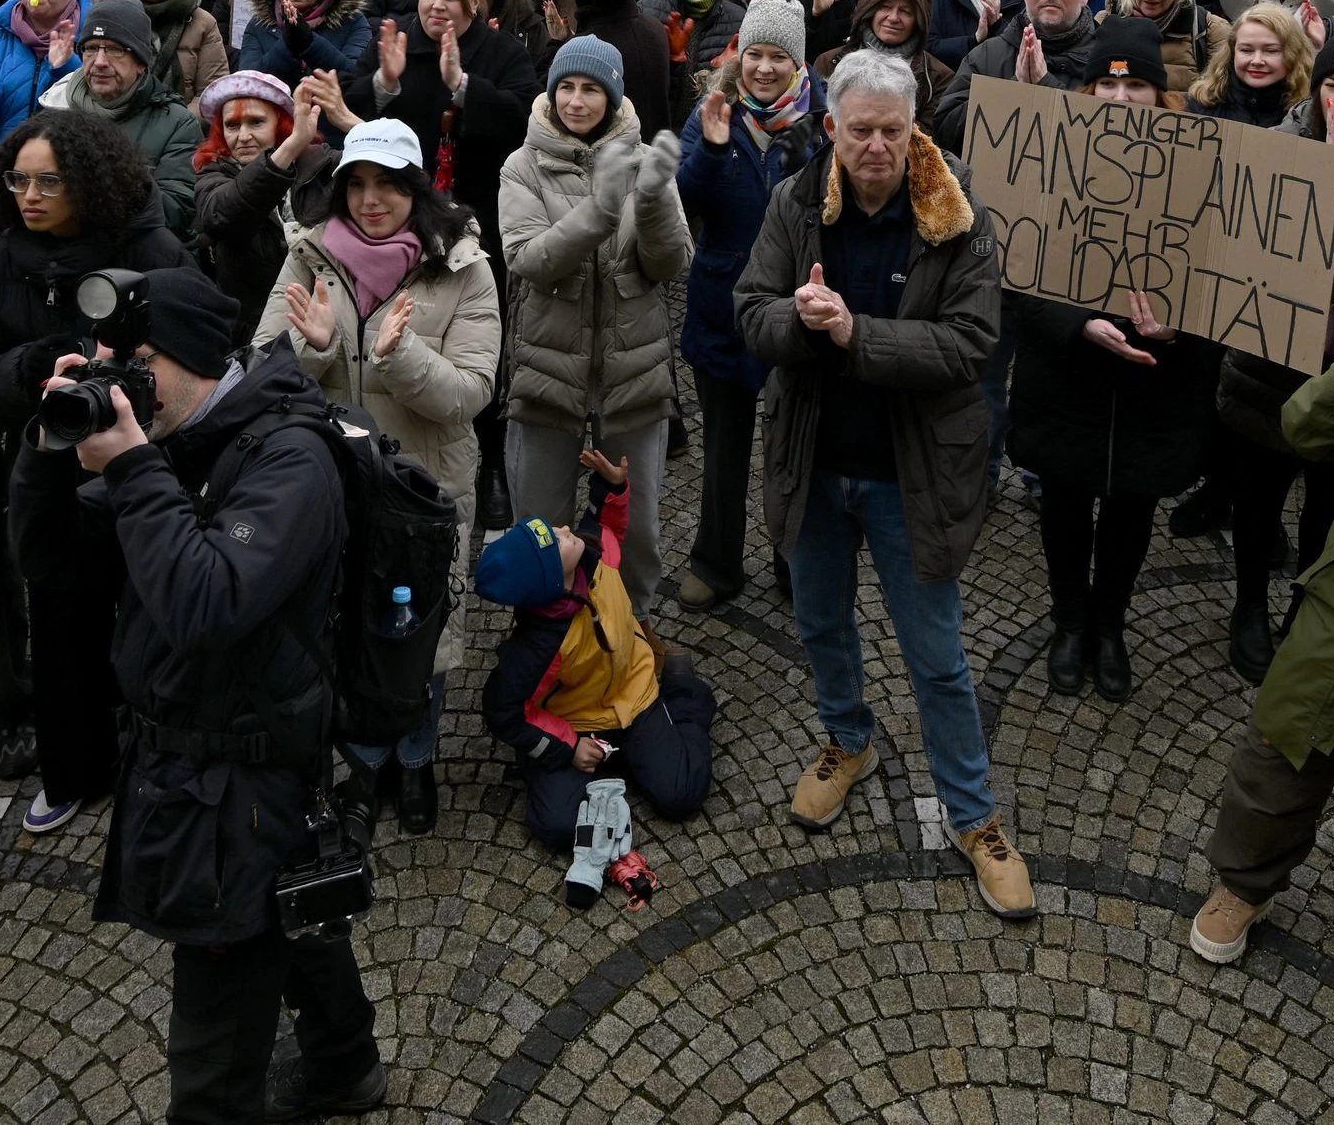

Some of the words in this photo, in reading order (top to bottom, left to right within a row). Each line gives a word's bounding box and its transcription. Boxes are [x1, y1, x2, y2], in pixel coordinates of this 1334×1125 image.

[1063, 96, 1223, 155] WENIGER
[975, 240, 992, 253] HR
[1059, 197, 1190, 261] MEHR
